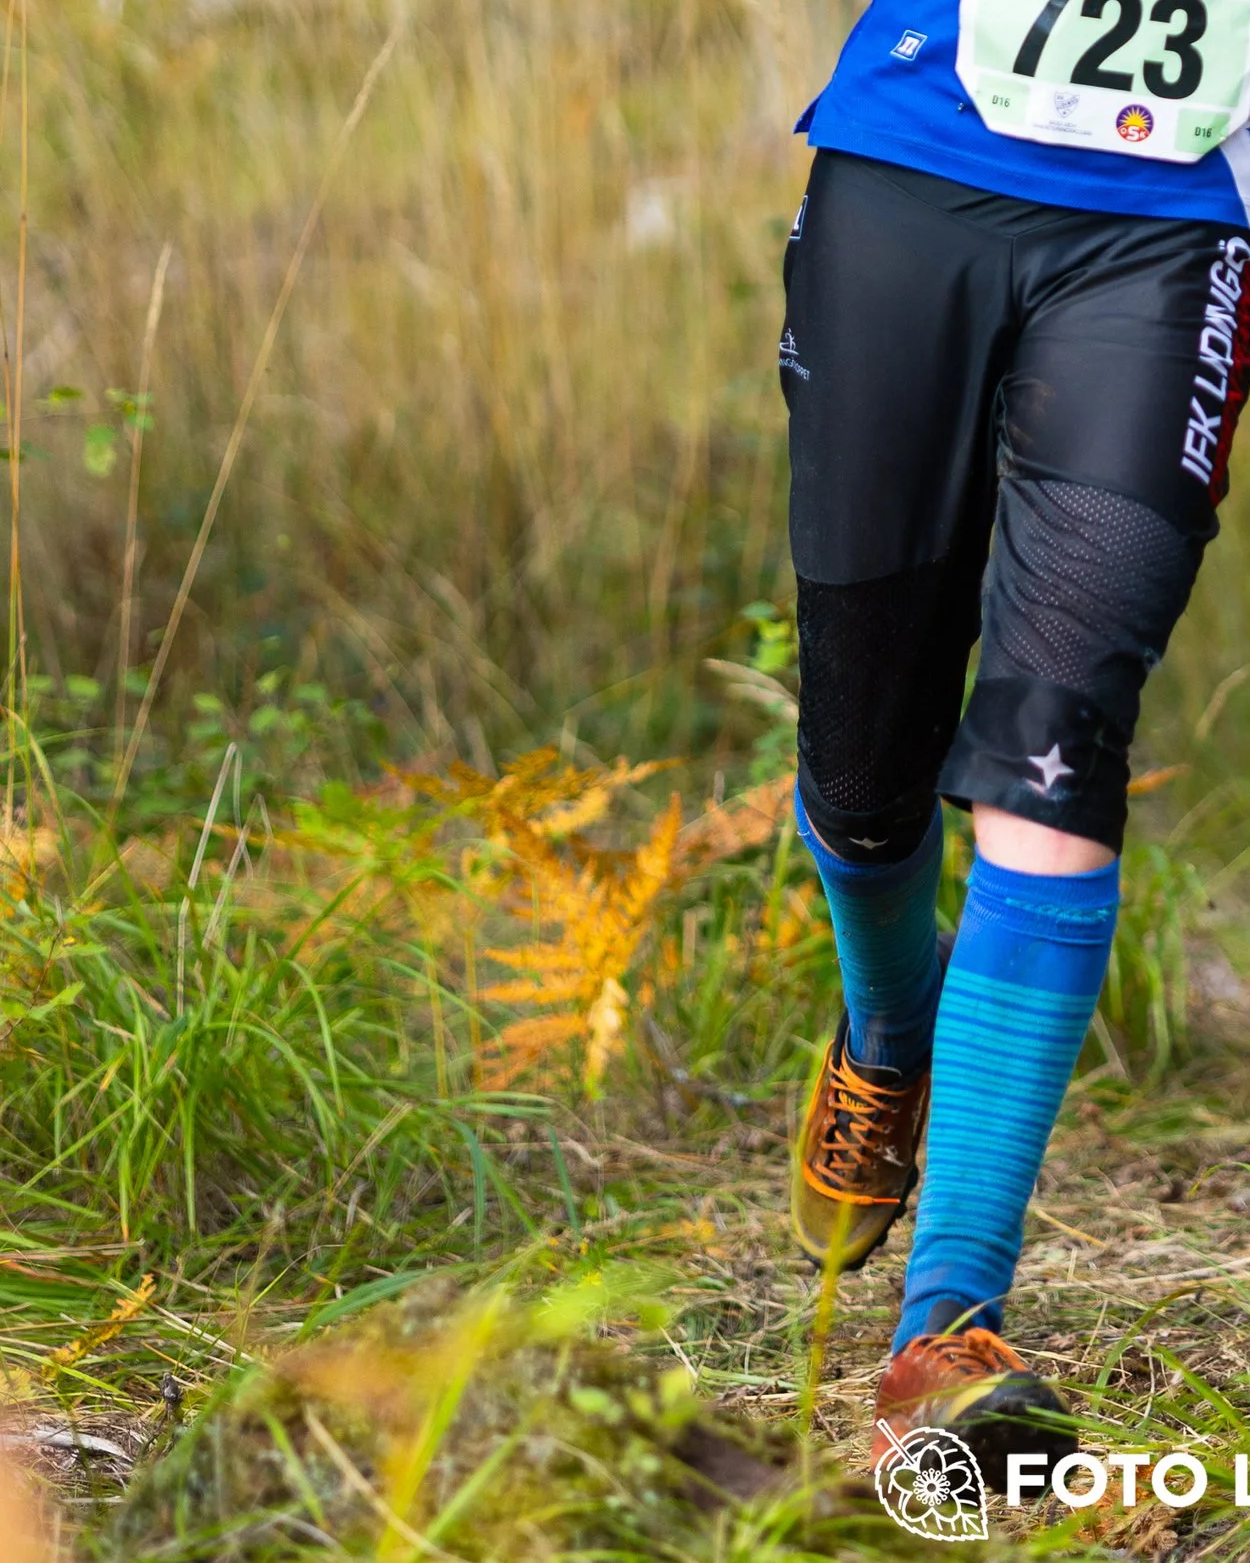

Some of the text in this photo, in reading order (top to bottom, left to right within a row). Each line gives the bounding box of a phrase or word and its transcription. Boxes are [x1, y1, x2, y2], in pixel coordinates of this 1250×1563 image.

[991, 94, 1010, 108] D16
[1194, 126, 1213, 139] D16
[1181, 395, 1222, 485] IFK
